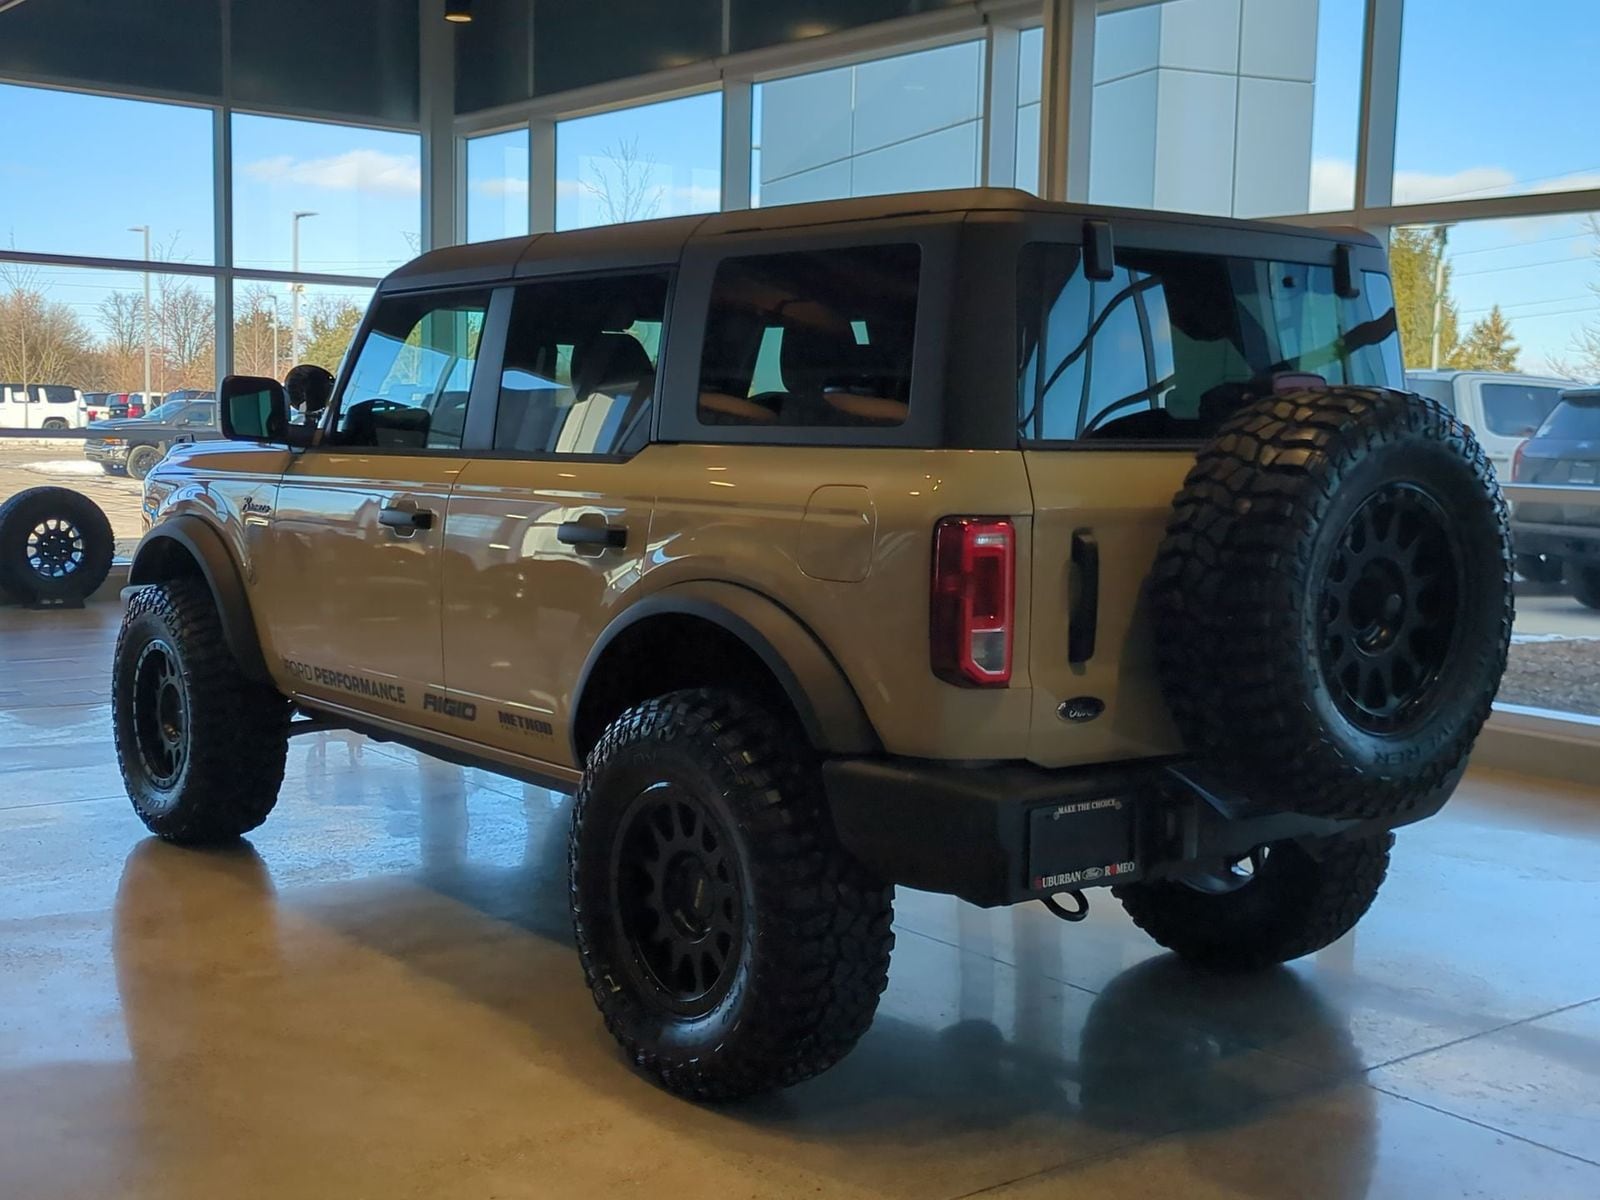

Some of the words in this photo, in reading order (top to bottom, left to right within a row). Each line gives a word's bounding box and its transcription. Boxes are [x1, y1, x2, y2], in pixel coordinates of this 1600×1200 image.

[314, 666, 406, 704] PERFORMANCE
[423, 692, 477, 722] RIGID
[497, 710, 553, 736] METHOD
[1058, 804, 1076, 815] MAKE
[1077, 802, 1090, 812] THE
[1034, 870, 1081, 888] UBURBAN
[1104, 861, 1135, 877] RMEO
